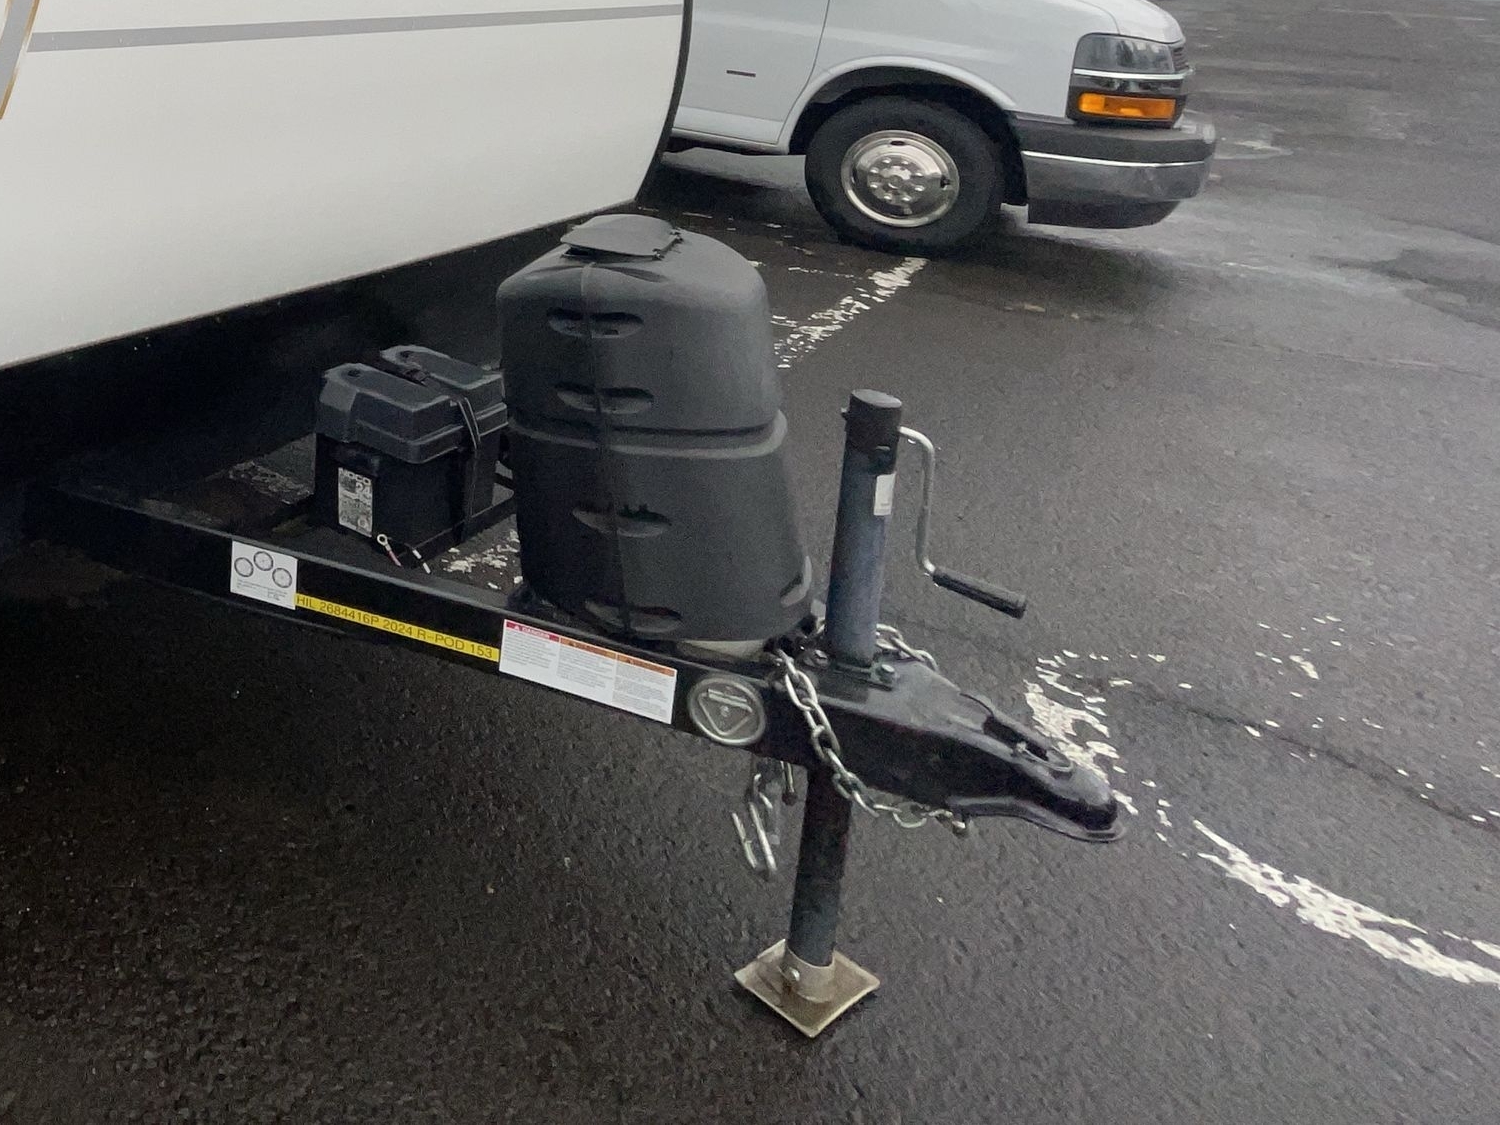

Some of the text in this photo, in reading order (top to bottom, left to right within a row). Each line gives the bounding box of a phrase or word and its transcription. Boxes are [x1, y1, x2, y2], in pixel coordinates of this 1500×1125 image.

[296, 595, 316, 609] HIL
[319, 602, 379, 626] 2684416P
[383, 619, 413, 636] 2024
[417, 629, 465, 651] R-POD
[469, 643, 493, 659] 153
